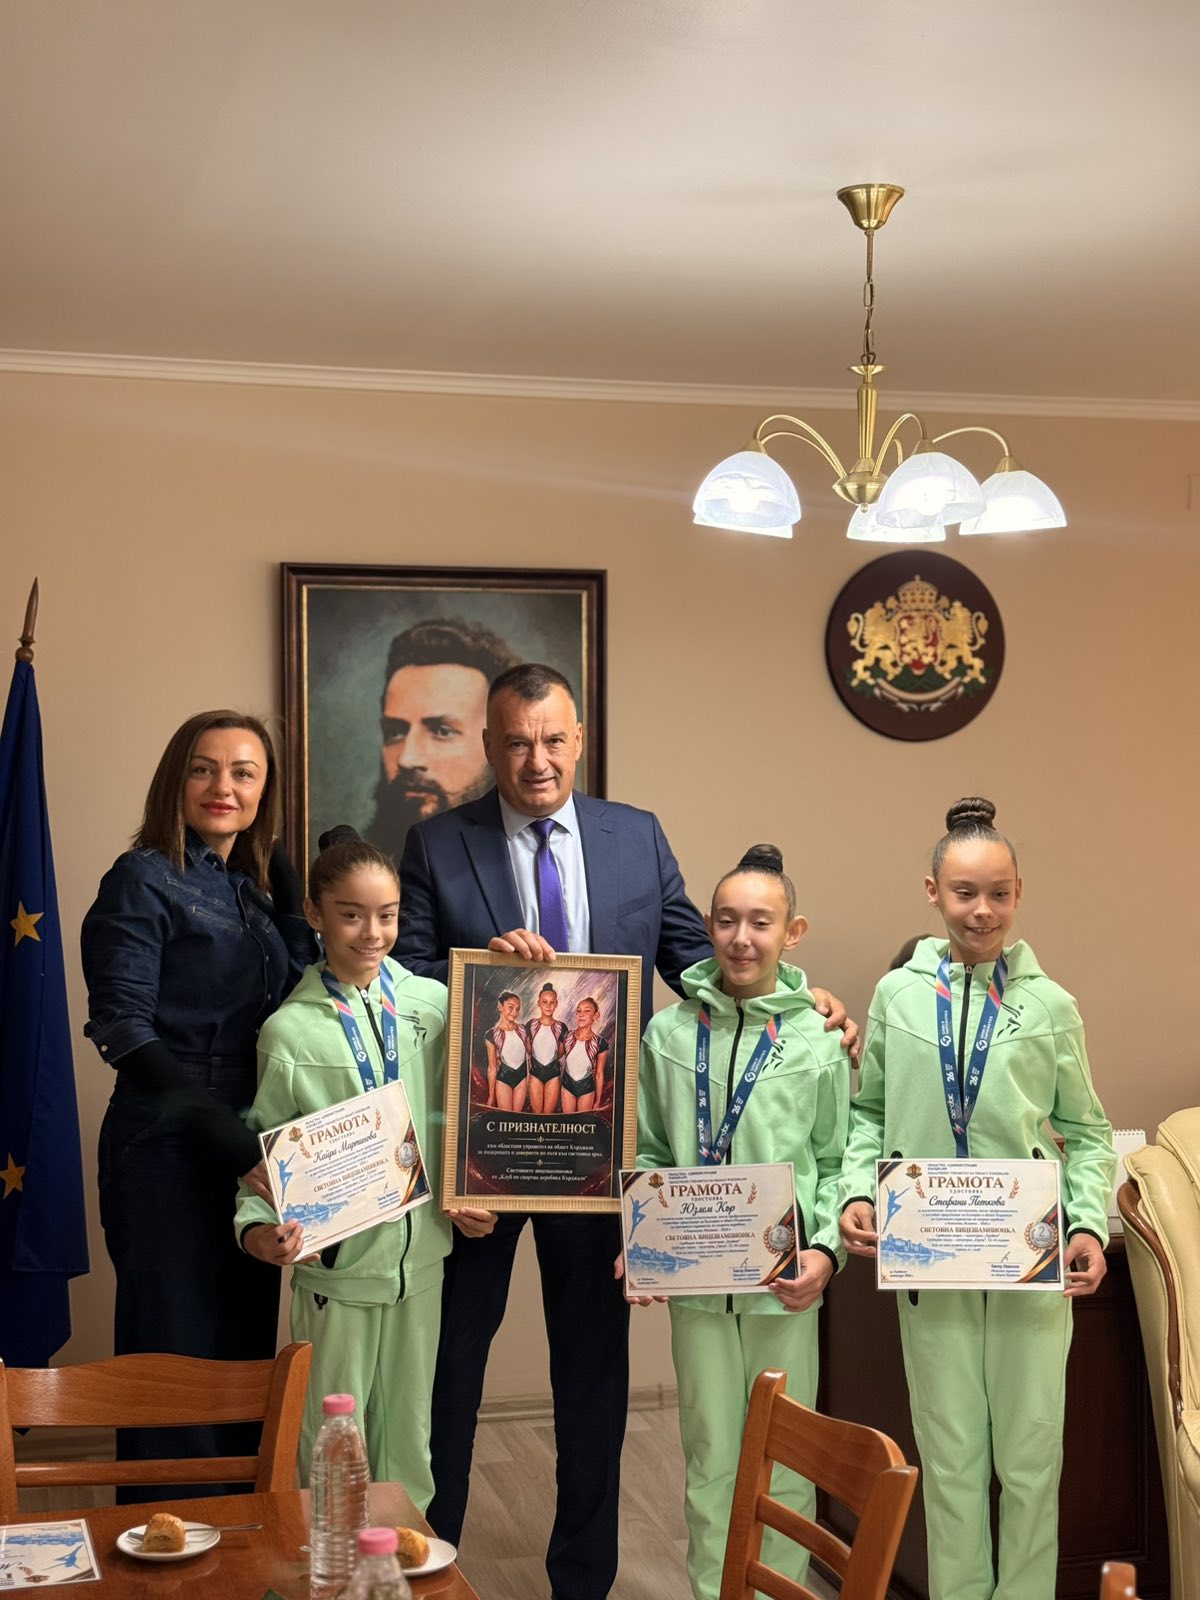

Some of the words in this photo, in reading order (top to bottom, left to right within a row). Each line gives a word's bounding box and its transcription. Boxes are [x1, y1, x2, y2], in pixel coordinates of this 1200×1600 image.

[946, 1072, 955, 1082] 26
[970, 1076, 978, 1086] 26
[698, 1096, 706, 1107] 26
[732, 1104, 740, 1114] 26
[309, 1114, 370, 1146] ГРАМОТА
[486, 1122, 496, 1132] С
[499, 1122, 597, 1134] ПРИЗНАТЕЛНОСТ
[928, 1176, 1004, 1188] ГРАМОТА
[670, 1183, 742, 1197] ГРАМОТА
[928, 1195, 968, 1208] Стефани
[968, 1195, 1006, 1206] Петкова
[680, 1202, 713, 1216] Юзлем
[715, 1202, 736, 1215] Кър
[776, 1228, 784, 1240] 2
[1039, 1225, 1046, 1237] 2
